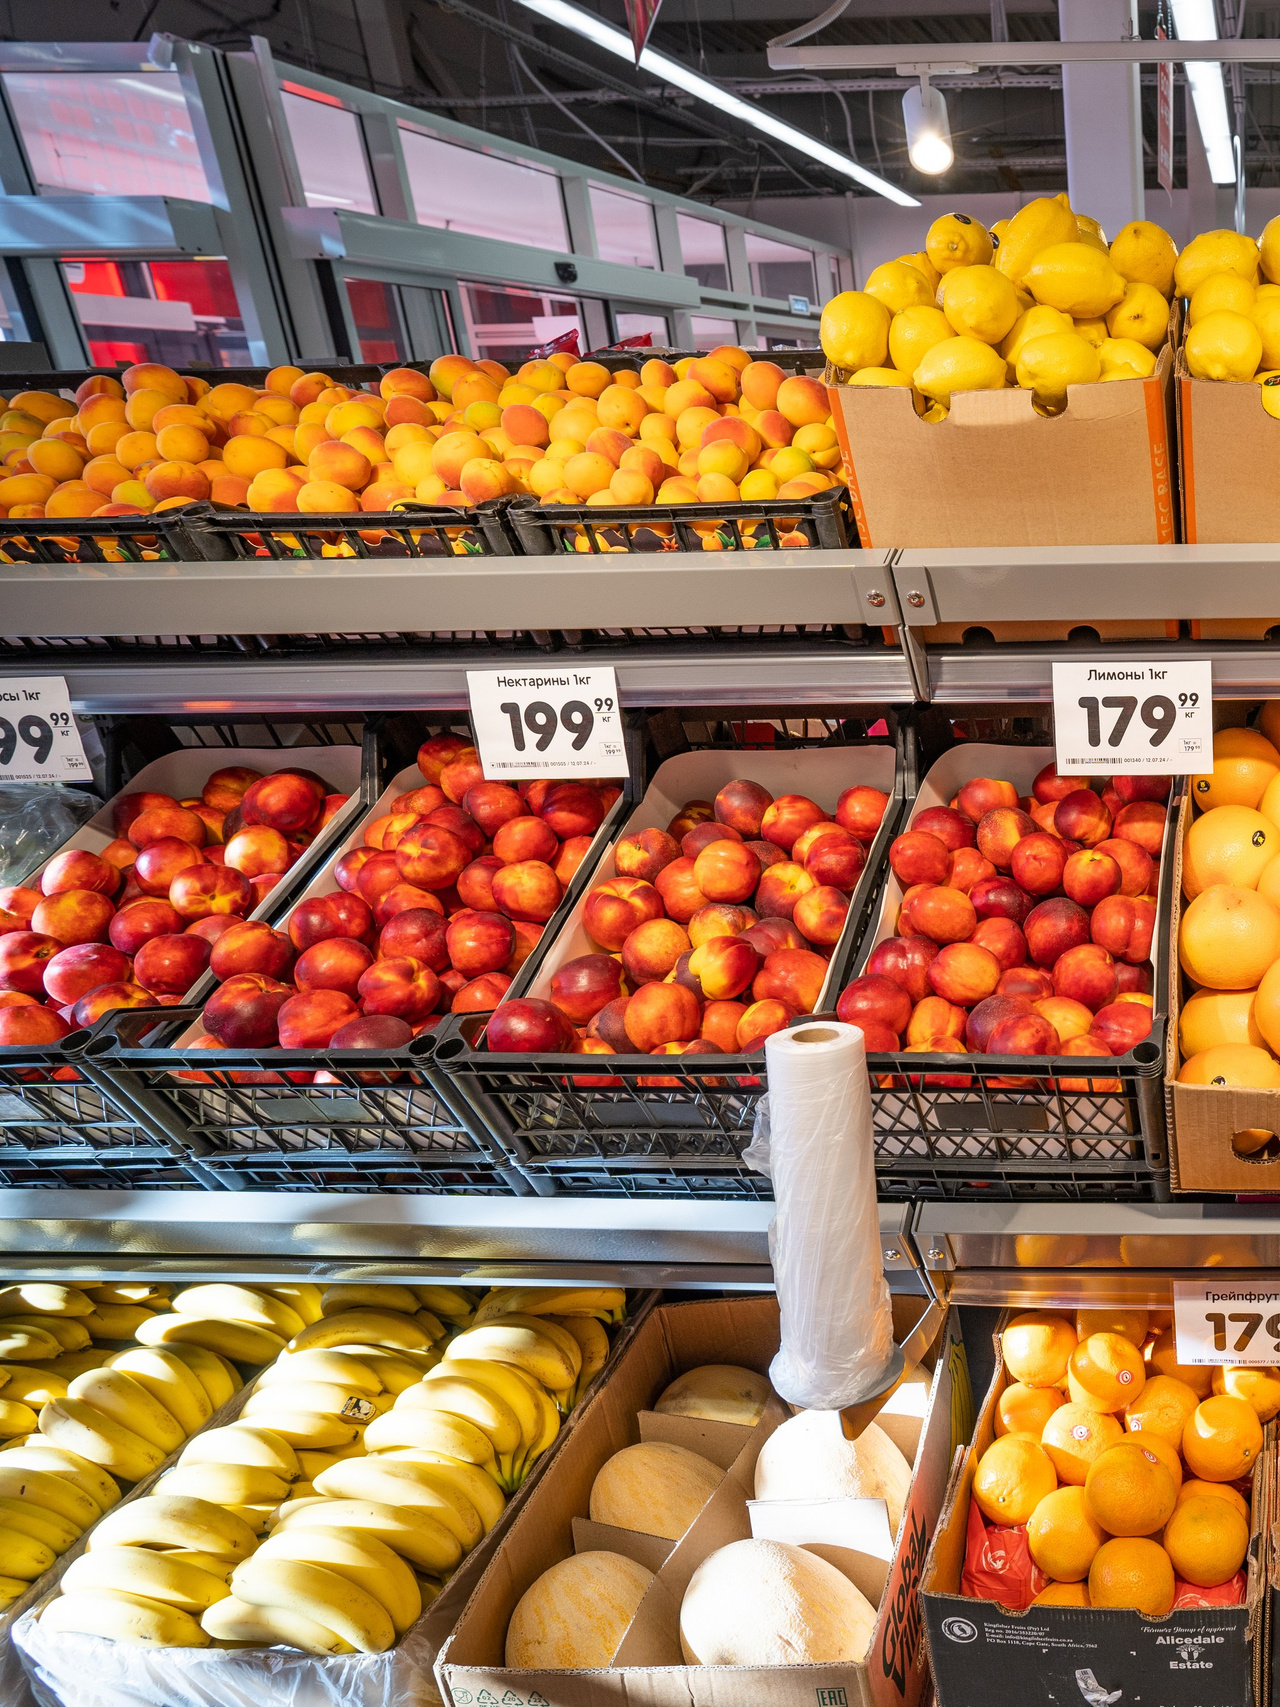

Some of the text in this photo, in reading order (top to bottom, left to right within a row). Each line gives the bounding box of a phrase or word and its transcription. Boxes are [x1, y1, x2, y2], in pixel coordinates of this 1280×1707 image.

[496, 674, 592, 689] Нектарины 1кг
[1087, 669, 1168, 681] Лимоны 1кг
[22, 689, 41, 702] 1кг
[49, 712, 70, 726] 99
[500, 697, 614, 752] 199 99
[1078, 692, 1199, 748] 179 99
[1205, 1291, 1280, 1303] Грейпфрут
[882, 1507, 926, 1678] Global
[1155, 1635, 1225, 1645] Alicedale
[1169, 1661, 1214, 1669] Estate
